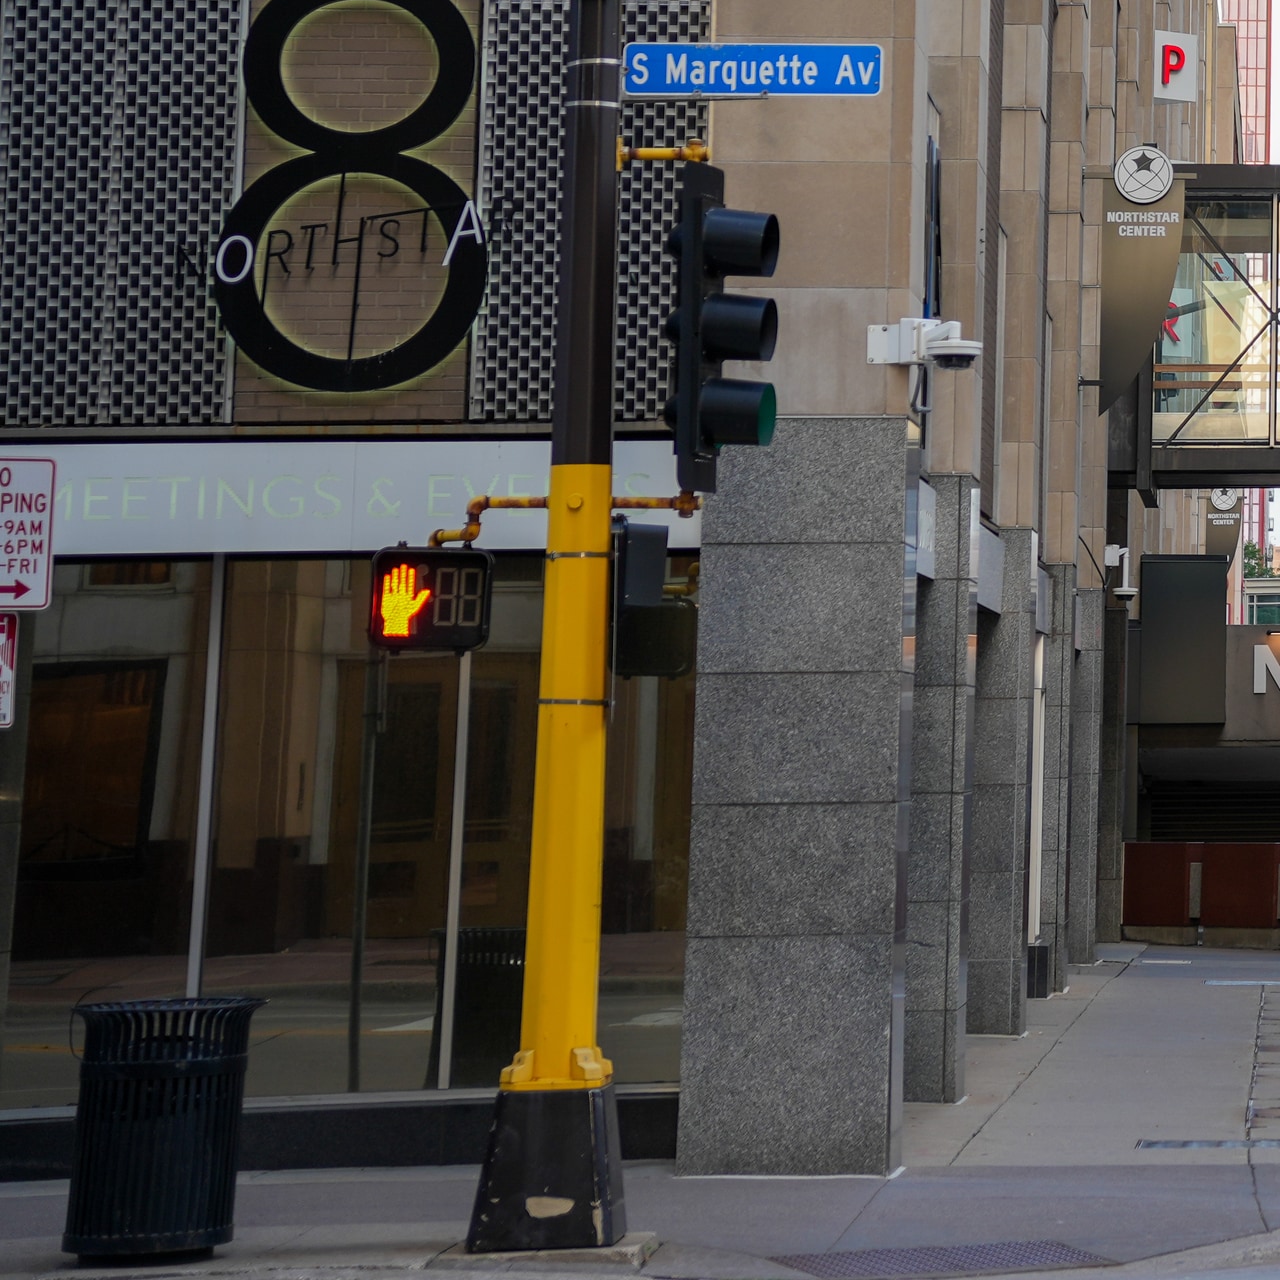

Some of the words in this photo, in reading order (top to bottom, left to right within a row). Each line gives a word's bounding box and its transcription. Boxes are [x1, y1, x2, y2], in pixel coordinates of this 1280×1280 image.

[631, 53, 650, 84] S
[665, 53, 819, 91] Marquette
[834, 54, 875, 85] Av
[1161, 44, 1186, 86] P
[1106, 210, 1180, 223] NORTHSTAR
[1118, 225, 1167, 237] CENTER
[366, 476, 402, 516] &
